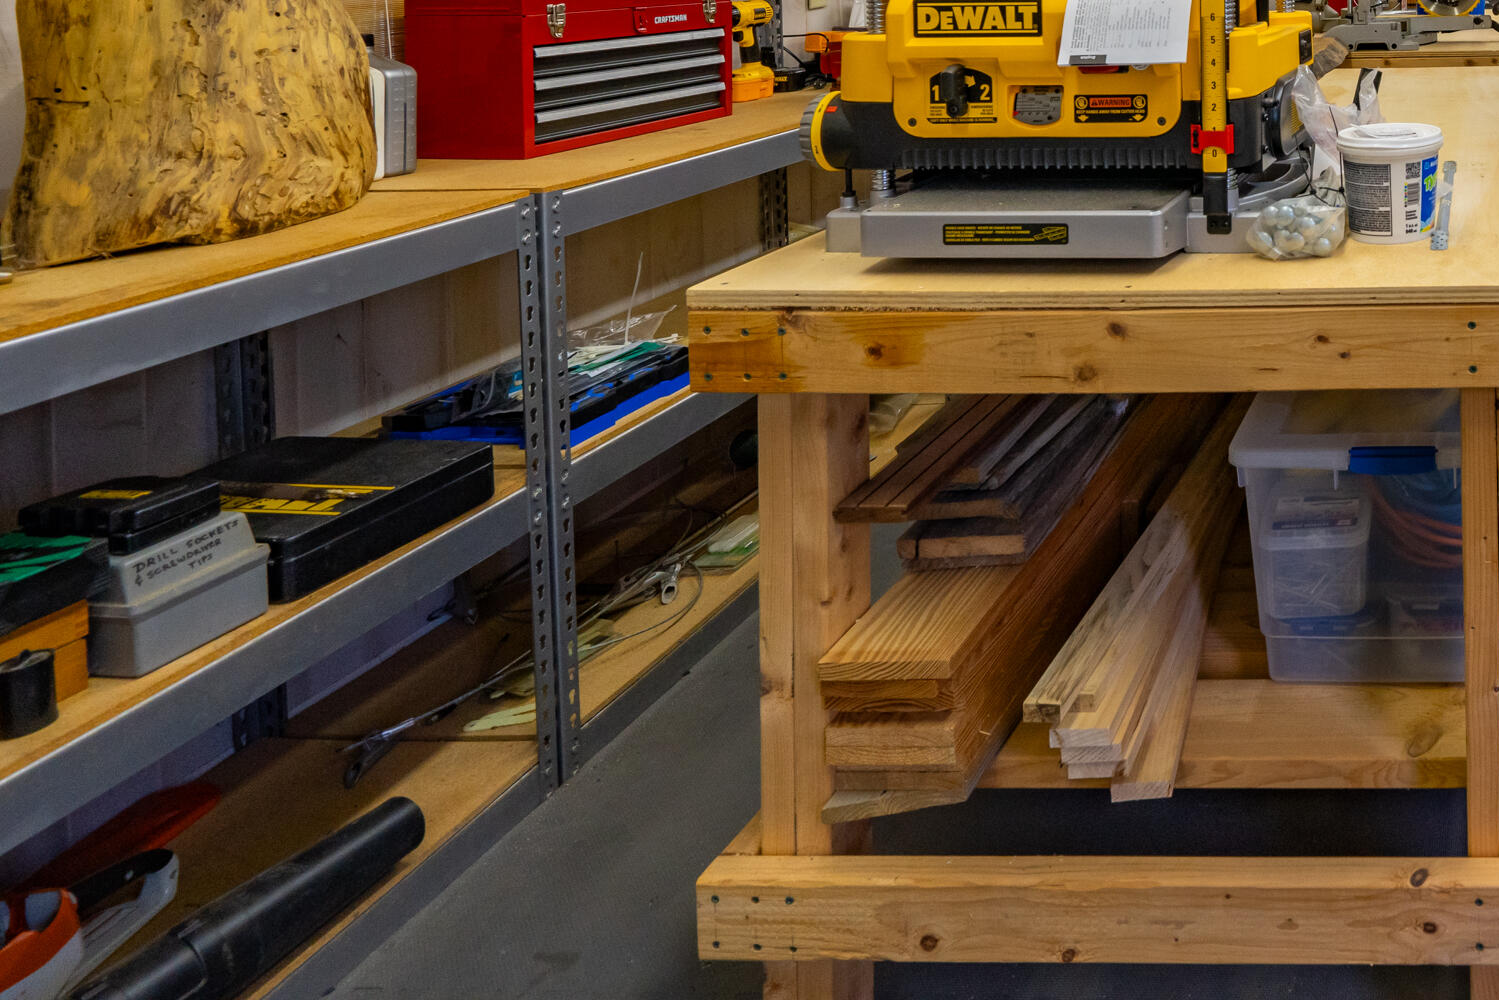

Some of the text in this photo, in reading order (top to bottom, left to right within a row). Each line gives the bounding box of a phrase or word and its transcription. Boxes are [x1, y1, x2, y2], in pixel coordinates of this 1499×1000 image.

[654, 14, 687, 24] CRAFTSMAN
[917, 5, 1038, 31] DEWALT
[1210, 13, 1216, 21] 6
[1210, 36, 1216, 44] 5
[1210, 58, 1216, 67] 4
[1211, 81, 1217, 89] 3
[931, 83, 990, 101] 1 2
[1097, 98, 1130, 106] WARNING
[1211, 103, 1217, 112] 2
[1211, 149, 1218, 158] 0
[133, 519, 239, 574] DRILL SOCKETS
[147, 538, 222, 580] SCREWDRIVER
[188, 552, 214, 571] TIPS
